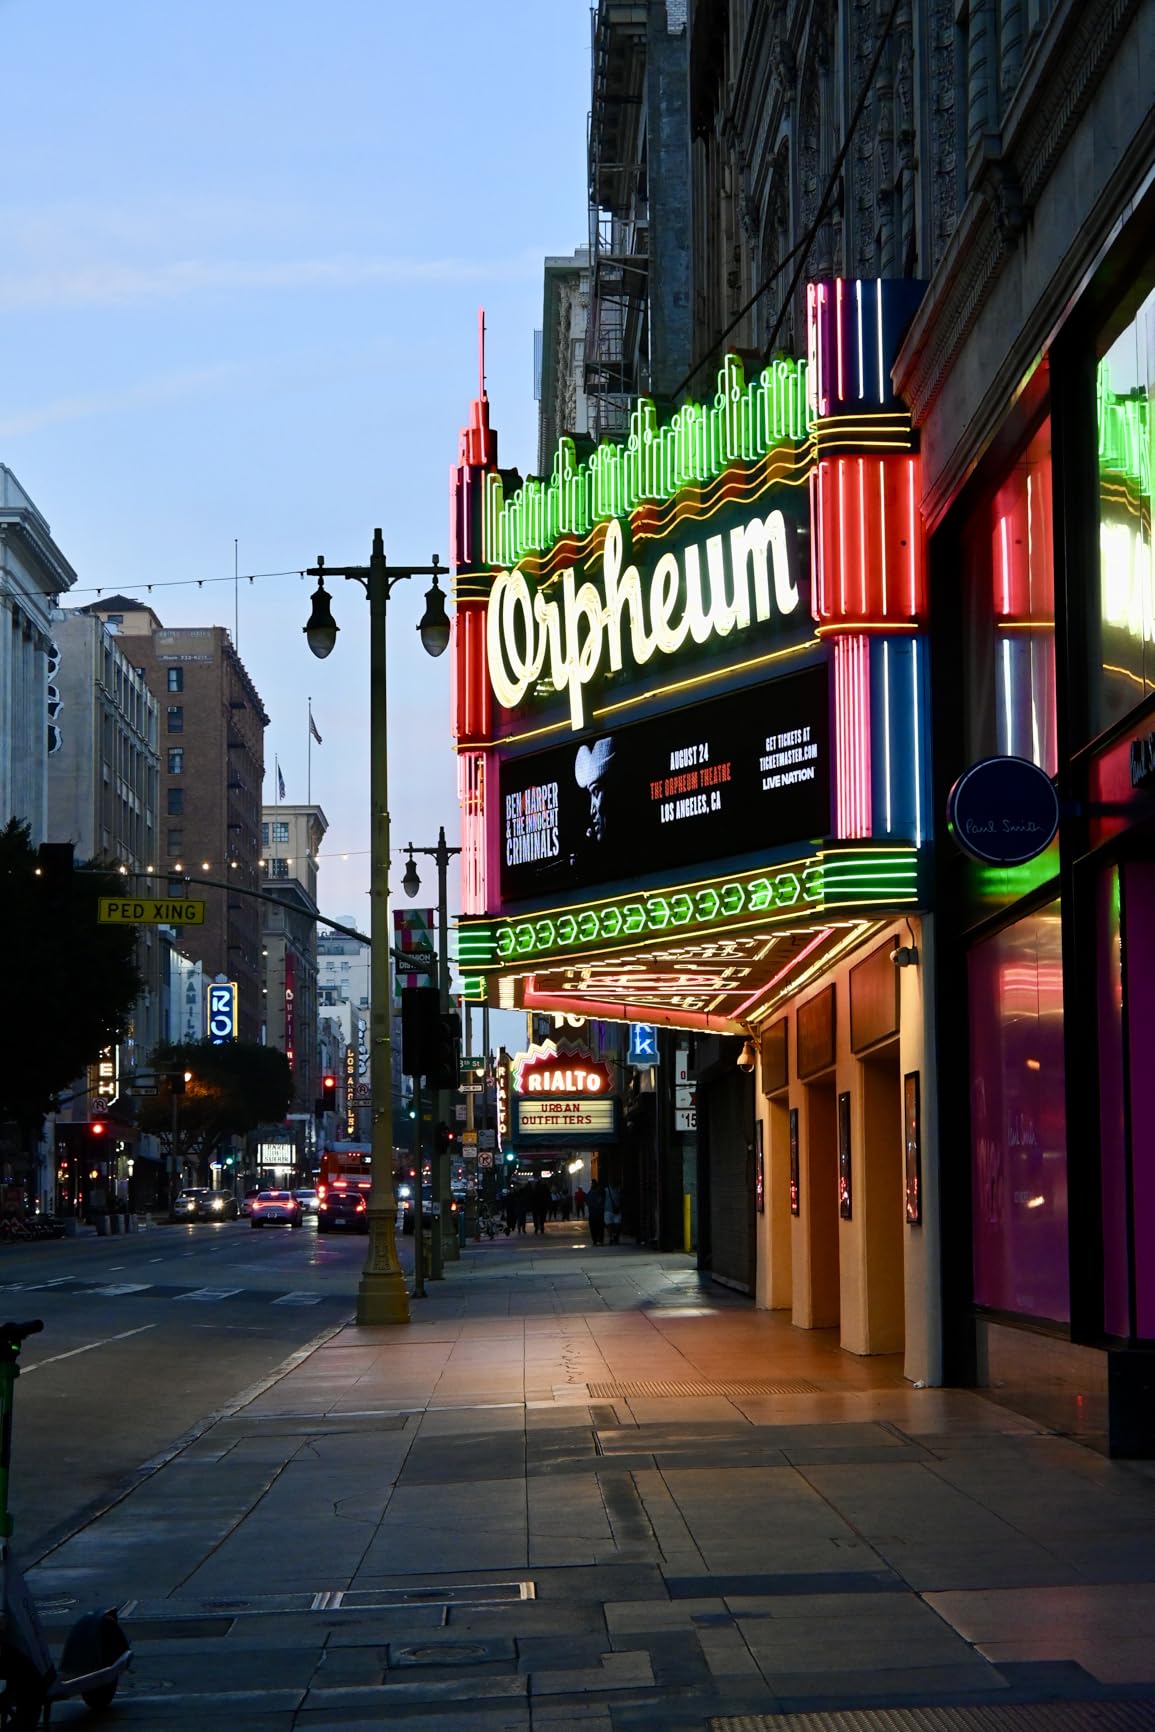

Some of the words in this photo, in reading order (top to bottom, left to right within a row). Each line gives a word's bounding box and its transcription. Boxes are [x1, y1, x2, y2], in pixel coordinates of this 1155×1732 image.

[487, 510, 799, 731] Orpheum
[766, 736, 776, 751] GET
[777, 729, 801, 749] TICKETS
[802, 727, 811, 742] AT
[670, 746, 697, 771] AUGUST
[699, 743, 709, 764] 24
[760, 744, 818, 771] TICKETMASTER.COM
[650, 780, 663, 800] THE
[664, 771, 698, 797] ORPHEUM
[700, 762, 732, 787] THEATRE
[762, 776, 781, 790] LIVE
[781, 767, 815, 786] NATION
[506, 792, 522, 819] BEN
[524, 782, 559, 814] HARPER
[661, 802, 675, 823] LOS
[676, 794, 710, 819] ANGELES,
[711, 790, 721, 811] CA
[506, 820, 511, 838] &
[513, 817, 525, 836] THE
[526, 808, 559, 833] INNOCENT
[966, 818, 997, 833] Paul
[1002, 819, 1044, 833] Smith
[506, 826, 560, 867] CRIMINALS
[107, 902, 145, 919] PED
[153, 902, 196, 920] XING
[210, 990, 232, 1045] RO
[528, 1070, 601, 1092] RIALTO
[499, 1067, 507, 1134] RIALTO
[541, 1103, 580, 1113] URBAN
